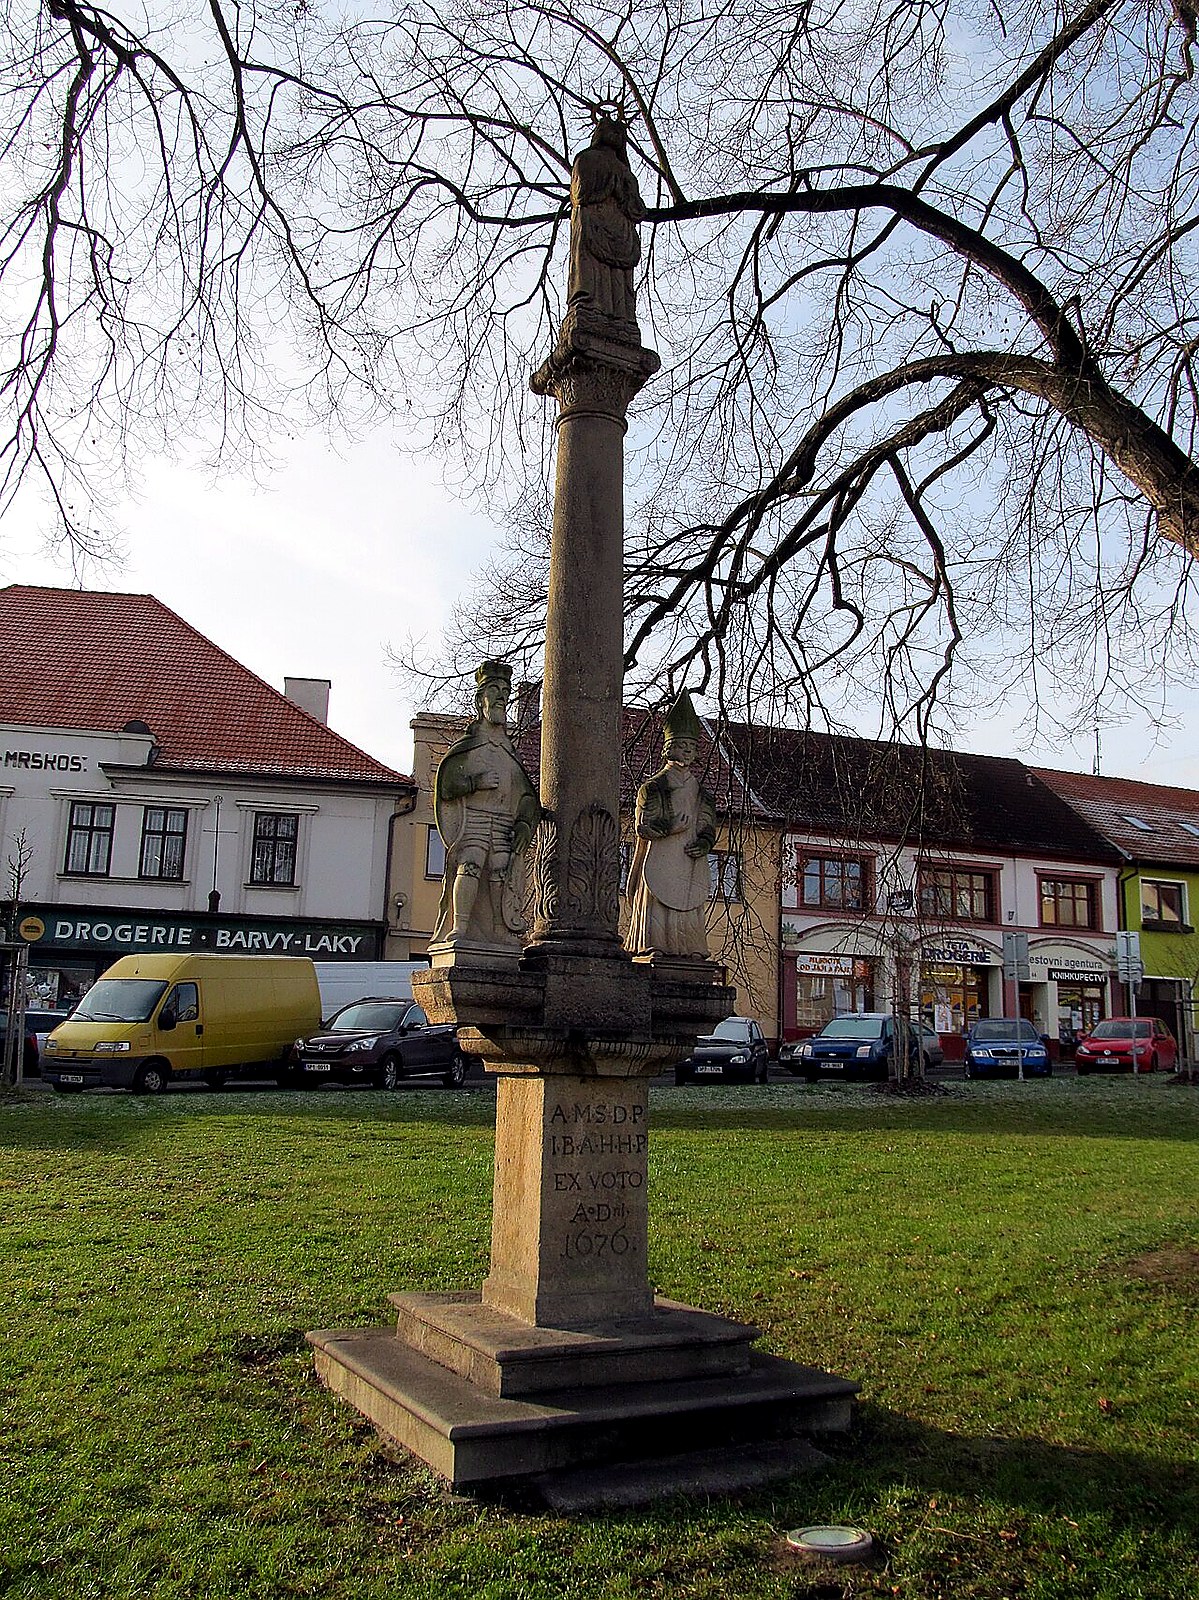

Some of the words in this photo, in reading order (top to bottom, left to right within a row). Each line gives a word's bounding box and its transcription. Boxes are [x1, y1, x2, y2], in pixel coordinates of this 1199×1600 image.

[54, 920, 193, 945] DROGERIE
[945, 941, 970, 950] TETA
[923, 947, 991, 963] DROGERIE
[1064, 959, 1103, 969] agentura
[554, 1172, 582, 1191] EX
[588, 1171, 643, 1190] VOTO
